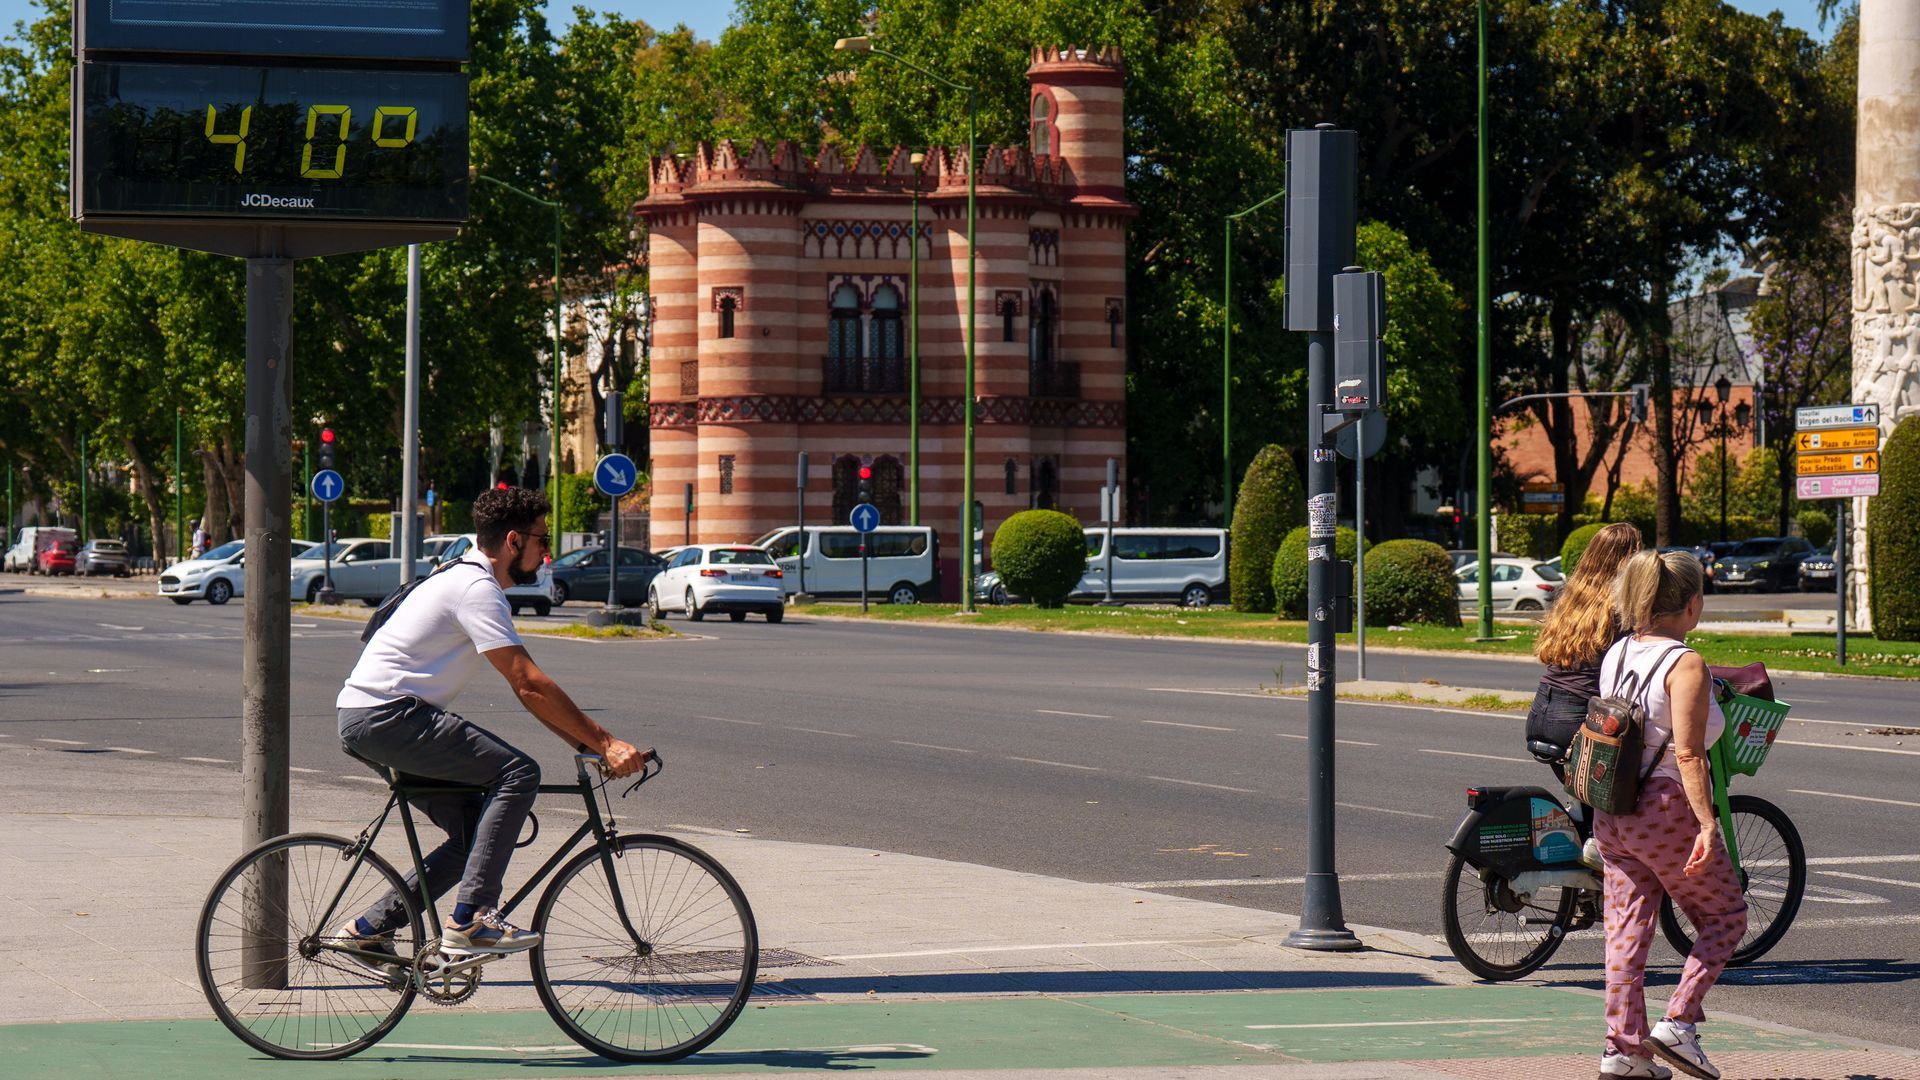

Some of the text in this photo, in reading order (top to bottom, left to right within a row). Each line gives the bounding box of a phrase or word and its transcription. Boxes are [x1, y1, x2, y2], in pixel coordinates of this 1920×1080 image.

[241, 194, 314, 209] JCDecaux
[1799, 417, 1820, 426] Virgen
[1821, 440, 1839, 448] Plaza
